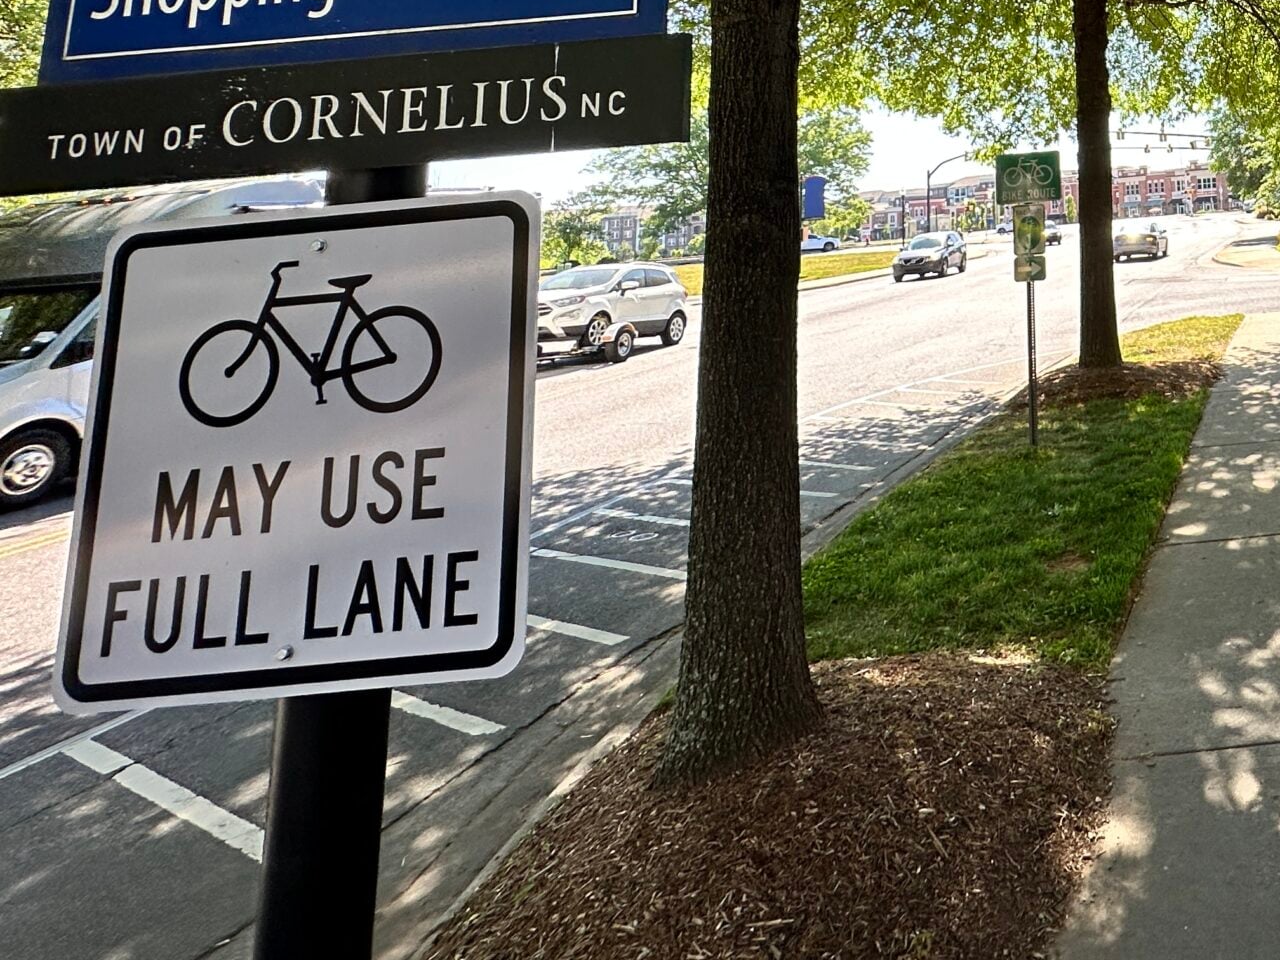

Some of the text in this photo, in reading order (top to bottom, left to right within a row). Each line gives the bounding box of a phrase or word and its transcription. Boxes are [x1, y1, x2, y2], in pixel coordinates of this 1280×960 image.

[47, 75, 627, 160] TOWN OF CORNELIUS NC
[1002, 190, 1022, 201] BIKE
[151, 446, 446, 544] MAY USE
[99, 549, 480, 658] FULL LANE
